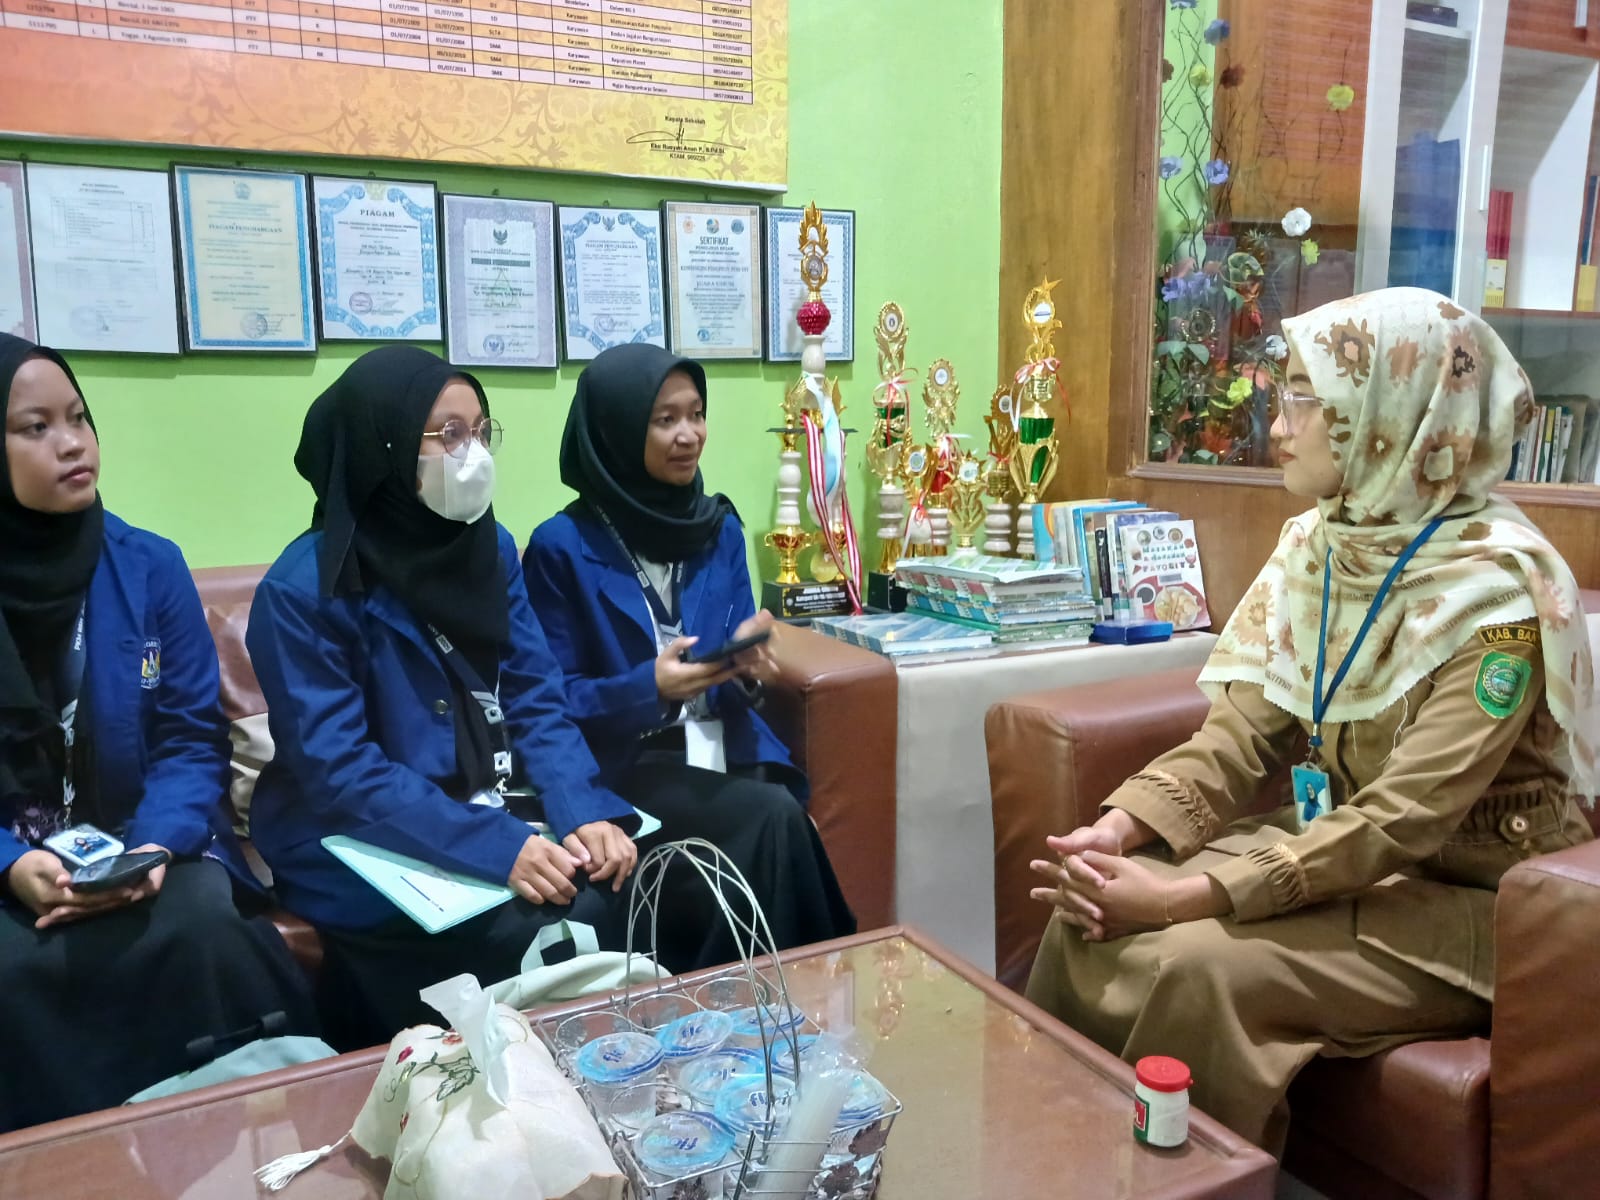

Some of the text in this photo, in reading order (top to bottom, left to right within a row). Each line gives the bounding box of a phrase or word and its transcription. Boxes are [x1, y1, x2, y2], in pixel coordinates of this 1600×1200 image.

[360, 208, 395, 217] PIAGAM
[700, 236, 729, 245] SERTIFIKAT
[1486, 629, 1513, 643] KAB.
